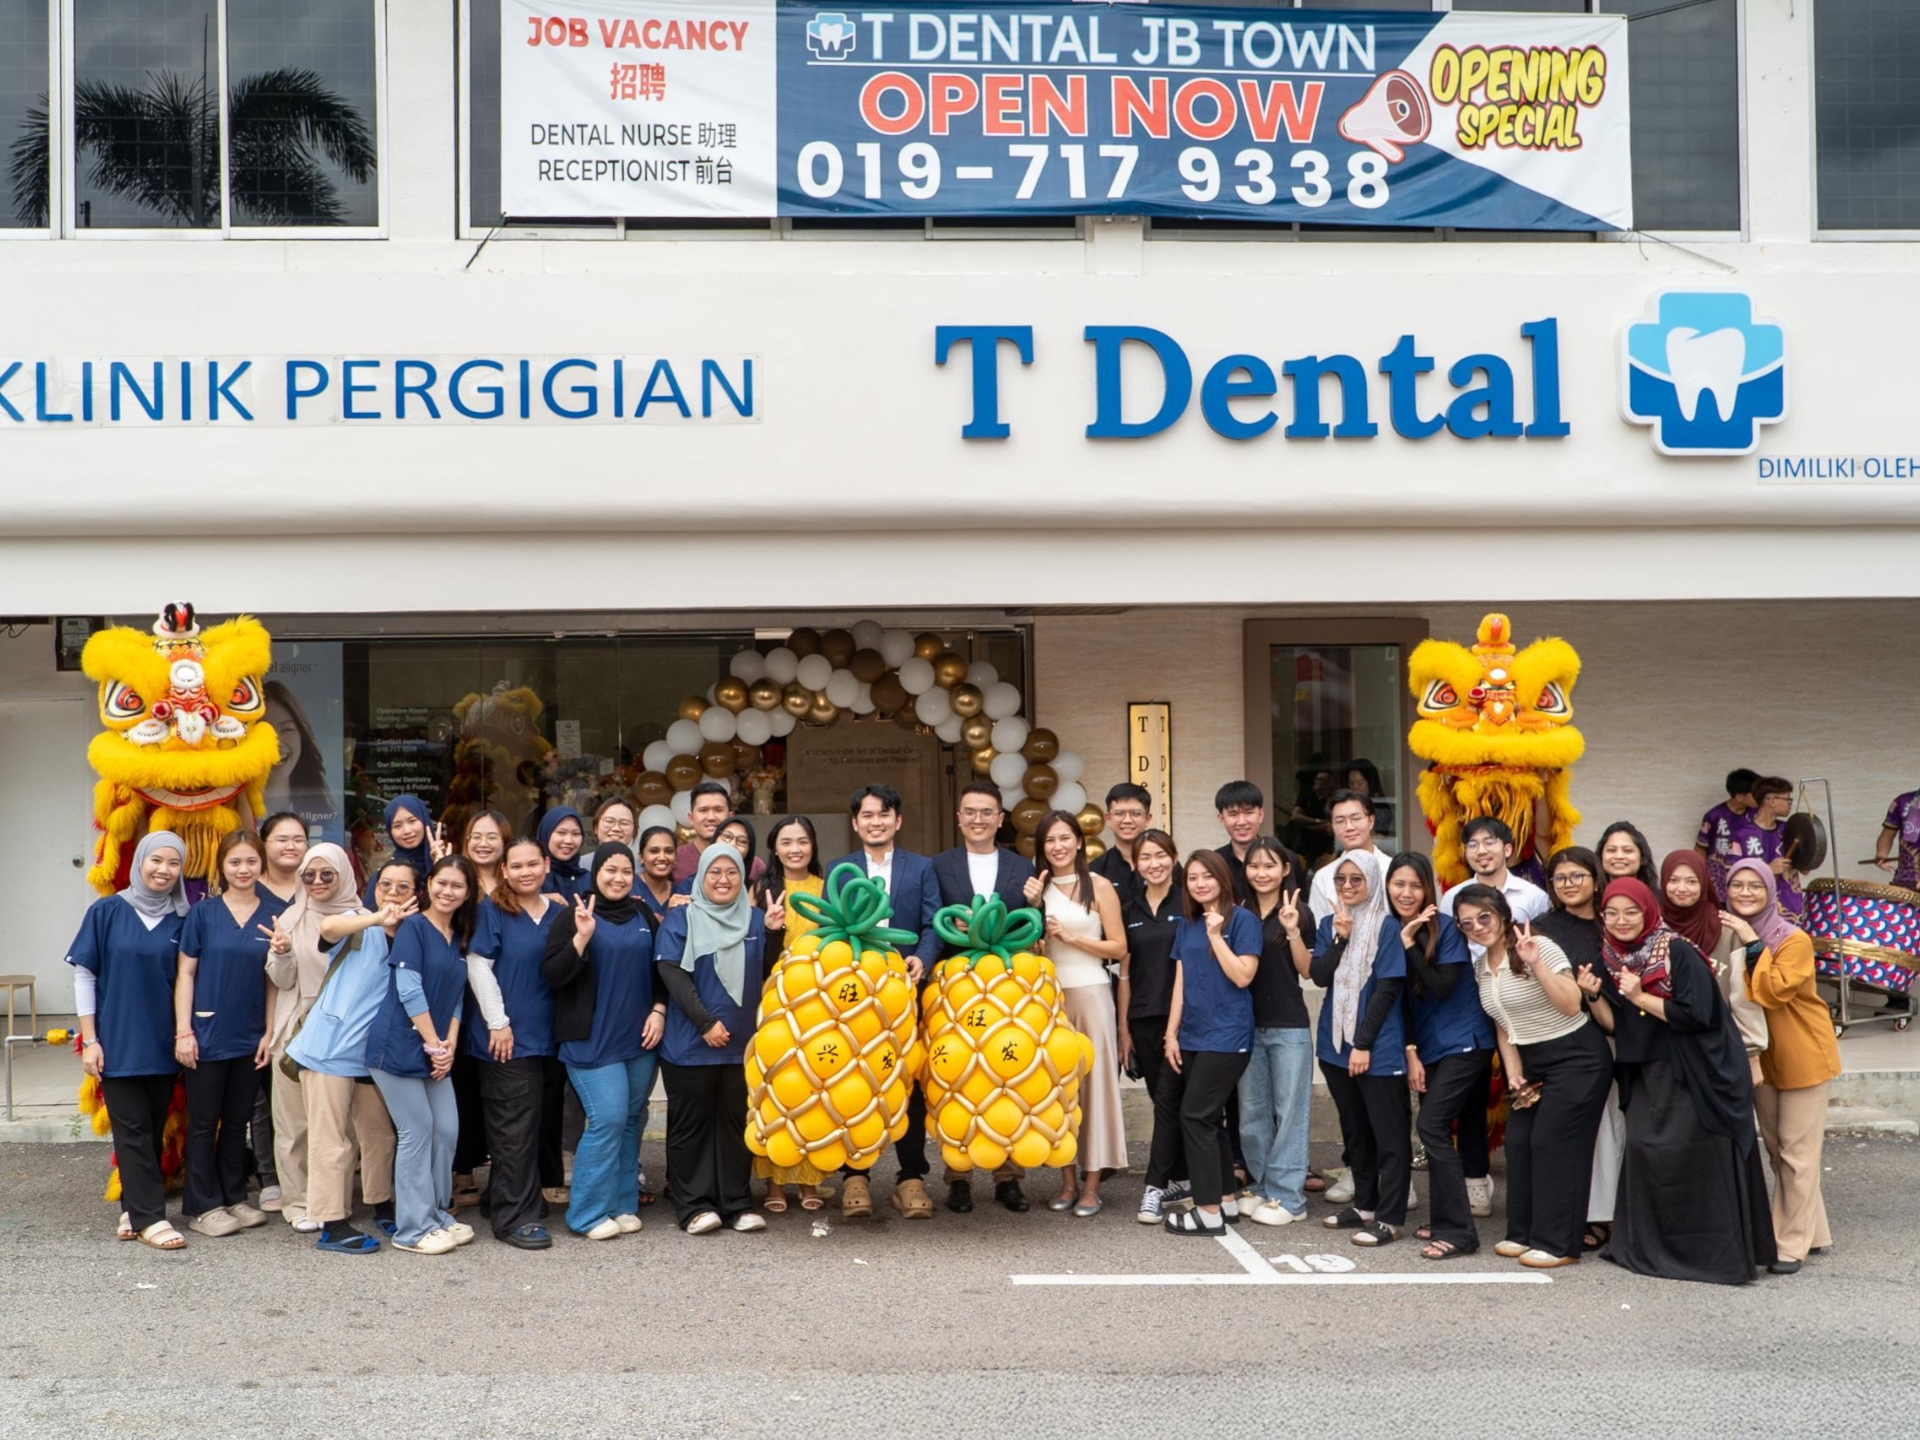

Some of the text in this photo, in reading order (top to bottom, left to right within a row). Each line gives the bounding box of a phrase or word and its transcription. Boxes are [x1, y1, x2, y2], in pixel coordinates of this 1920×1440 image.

[527, 16, 749, 51] JOB VACANCY
[862, 13, 1376, 71] T DENTAL JB TOWN
[610, 62, 666, 102] 招聘
[1430, 44, 1607, 108] OPENING
[858, 71, 1327, 144] OPEN NOW
[530, 122, 737, 149] DENTAL NURSE 助理
[1457, 102, 1583, 151] SPECIAL
[538, 156, 733, 185] RECEPTIONIST 前台
[1178, 147, 1390, 209] 9338
[285, 357, 754, 421] PERGIGIAN
[933, 316, 1572, 441] T Dental
[1759, 457, 1920, 479] DIMILIKI OLEH
[1138, 716, 1148, 733] T
[967, 1009, 987, 1027] 旺
[817, 1044, 838, 1063] 兴
[932, 1041, 1018, 1065] 兴 发
